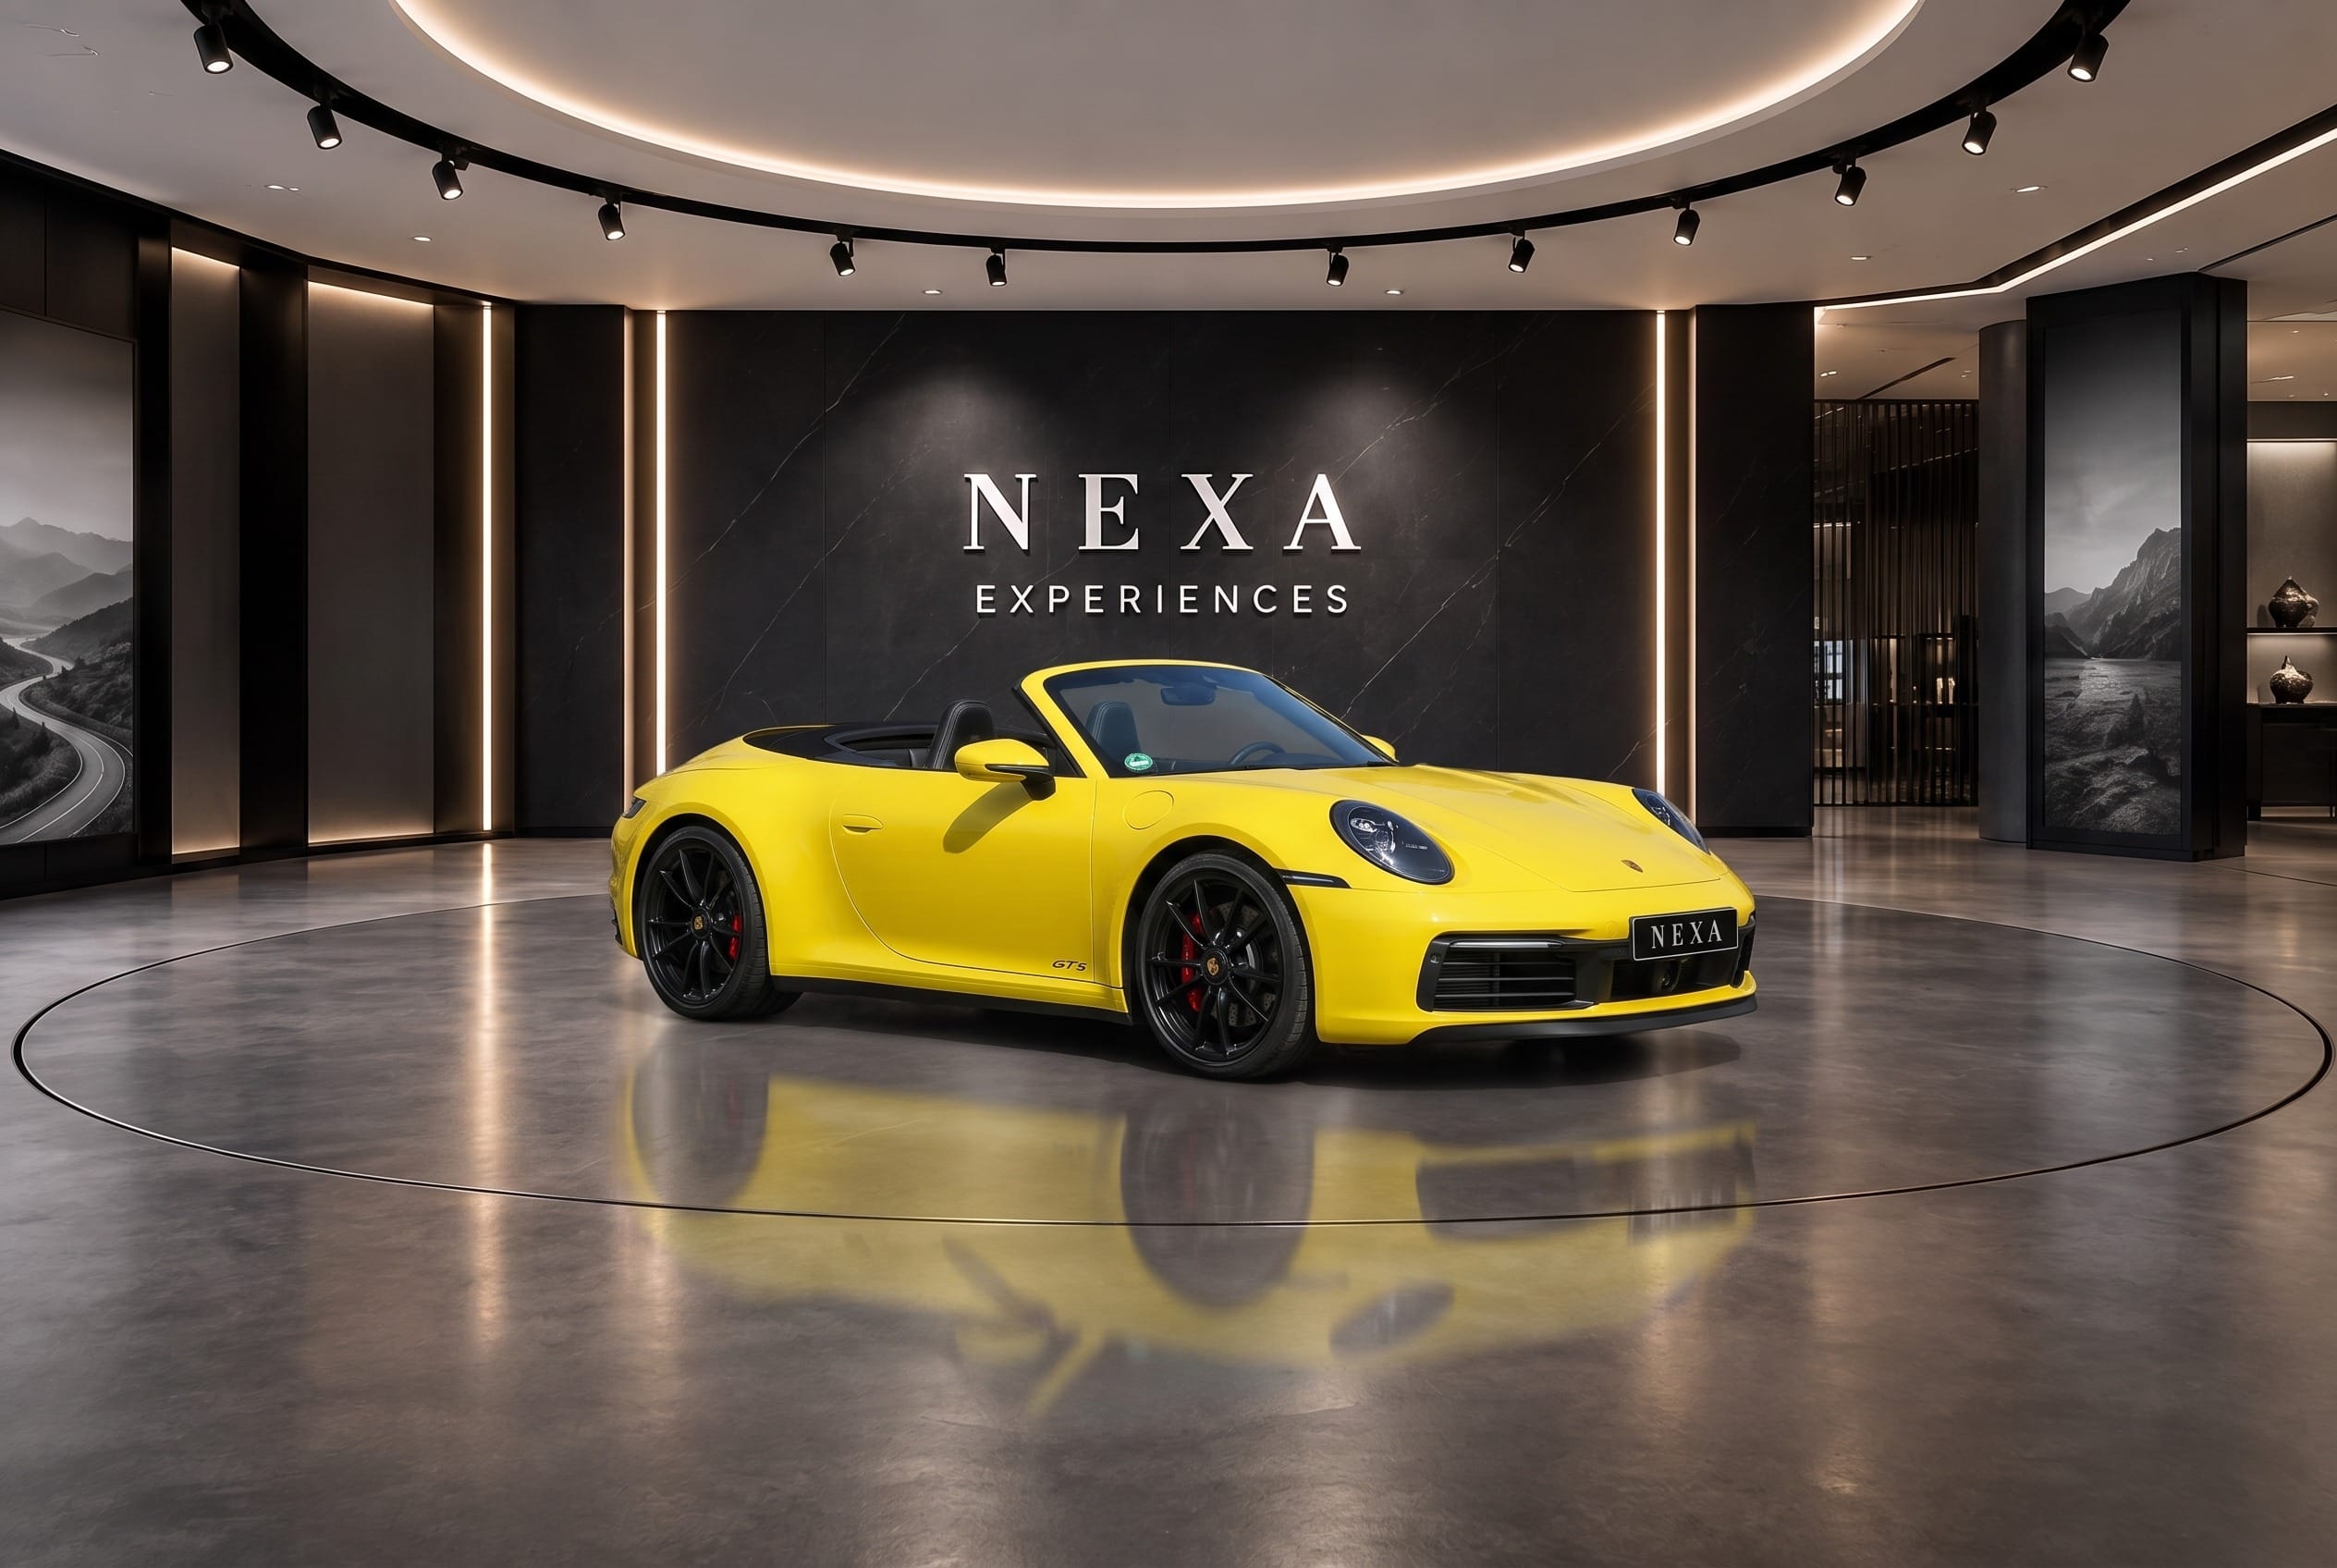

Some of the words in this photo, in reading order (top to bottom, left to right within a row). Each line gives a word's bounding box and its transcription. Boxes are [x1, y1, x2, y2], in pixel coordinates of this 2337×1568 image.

[963, 473, 1362, 550] NEXA
[975, 584, 1348, 614] EXPERIENCES
[1650, 918, 1722, 949] NEXA
[1052, 960, 1087, 972] GTS
